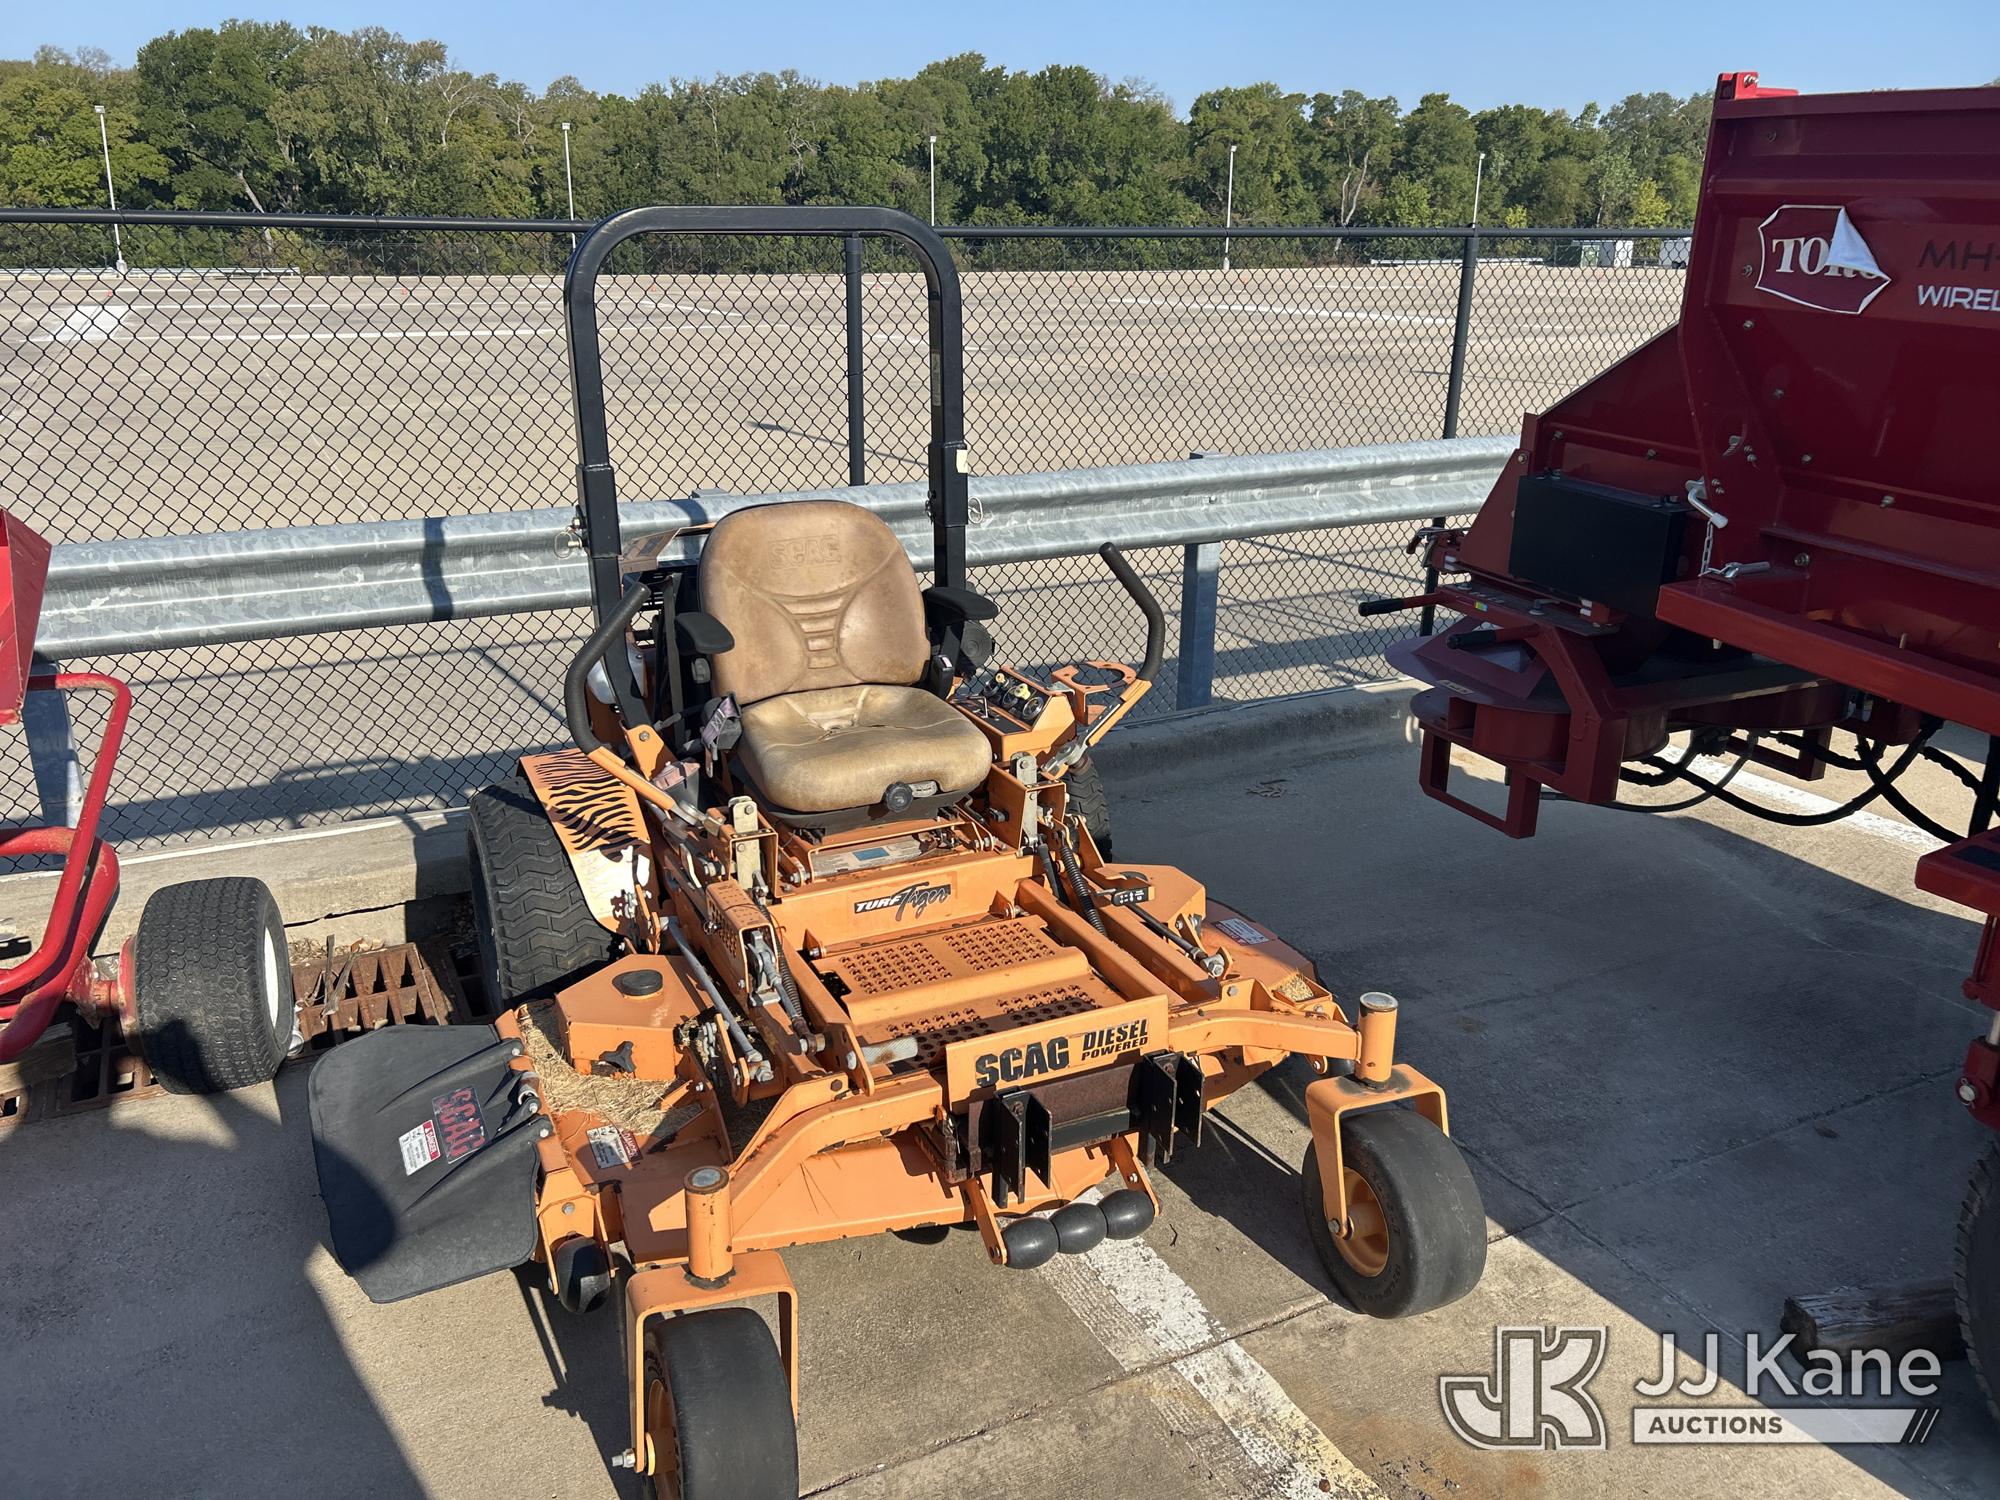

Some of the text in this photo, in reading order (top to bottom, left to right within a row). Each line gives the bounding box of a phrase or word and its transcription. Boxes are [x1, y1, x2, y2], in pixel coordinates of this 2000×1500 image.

[1772, 237, 1879, 279] TO
[856, 882, 948, 921] TURF Tiger
[975, 1019, 1148, 1088] SCAG DIESEL
[1081, 1037, 1148, 1061] POWERED
[434, 1089, 486, 1157] SCAG
